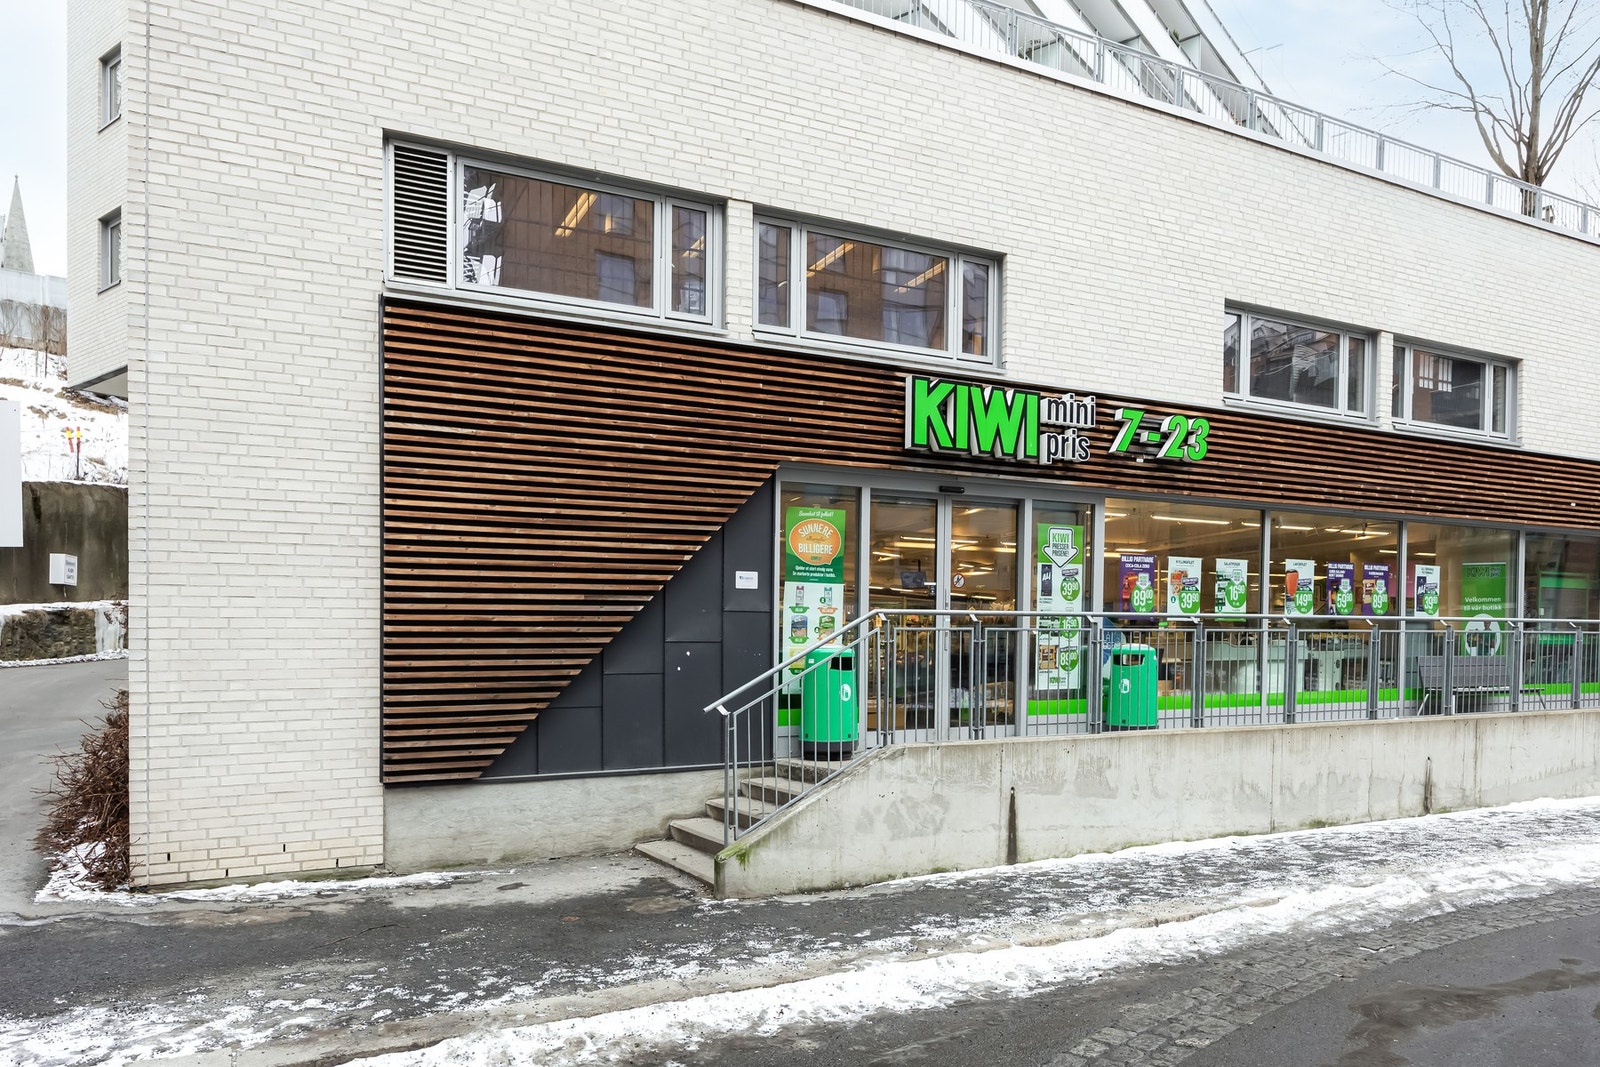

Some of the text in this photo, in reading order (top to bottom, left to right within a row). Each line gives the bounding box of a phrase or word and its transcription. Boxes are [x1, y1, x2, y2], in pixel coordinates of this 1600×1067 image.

[909, 376, 1096, 459] KIWI mini
[1046, 430, 1091, 464] pris
[1116, 408, 1211, 462] 7-23
[798, 523, 833, 538] SUNNERE
[1052, 533, 1070, 543] KIWI
[798, 543, 833, 554] BILLIGERE
